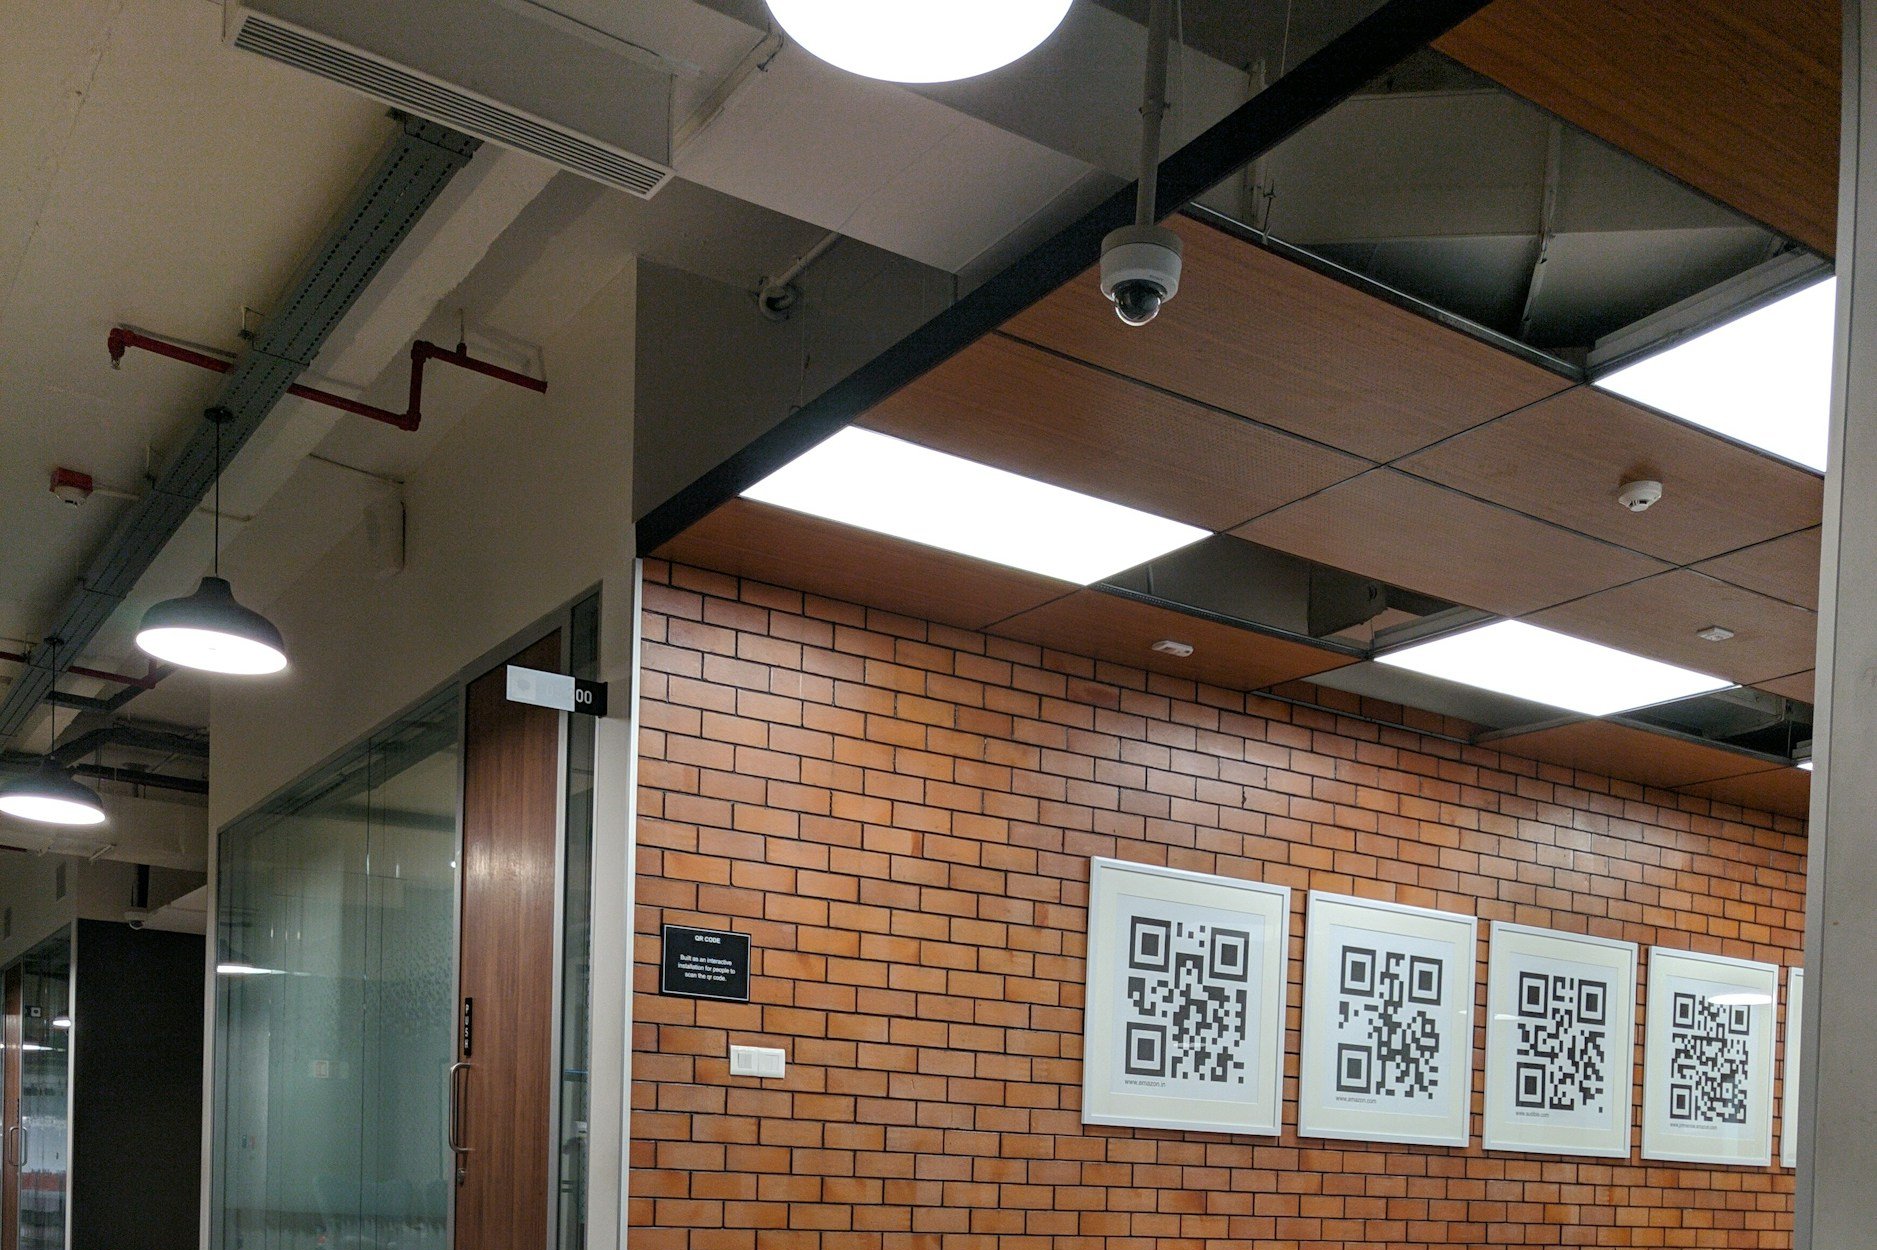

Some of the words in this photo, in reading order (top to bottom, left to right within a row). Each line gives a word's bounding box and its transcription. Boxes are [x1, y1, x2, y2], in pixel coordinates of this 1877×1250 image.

[704, 936, 721, 945] CODE
[678, 962, 704, 970] installation
[707, 957, 732, 966] interactive
